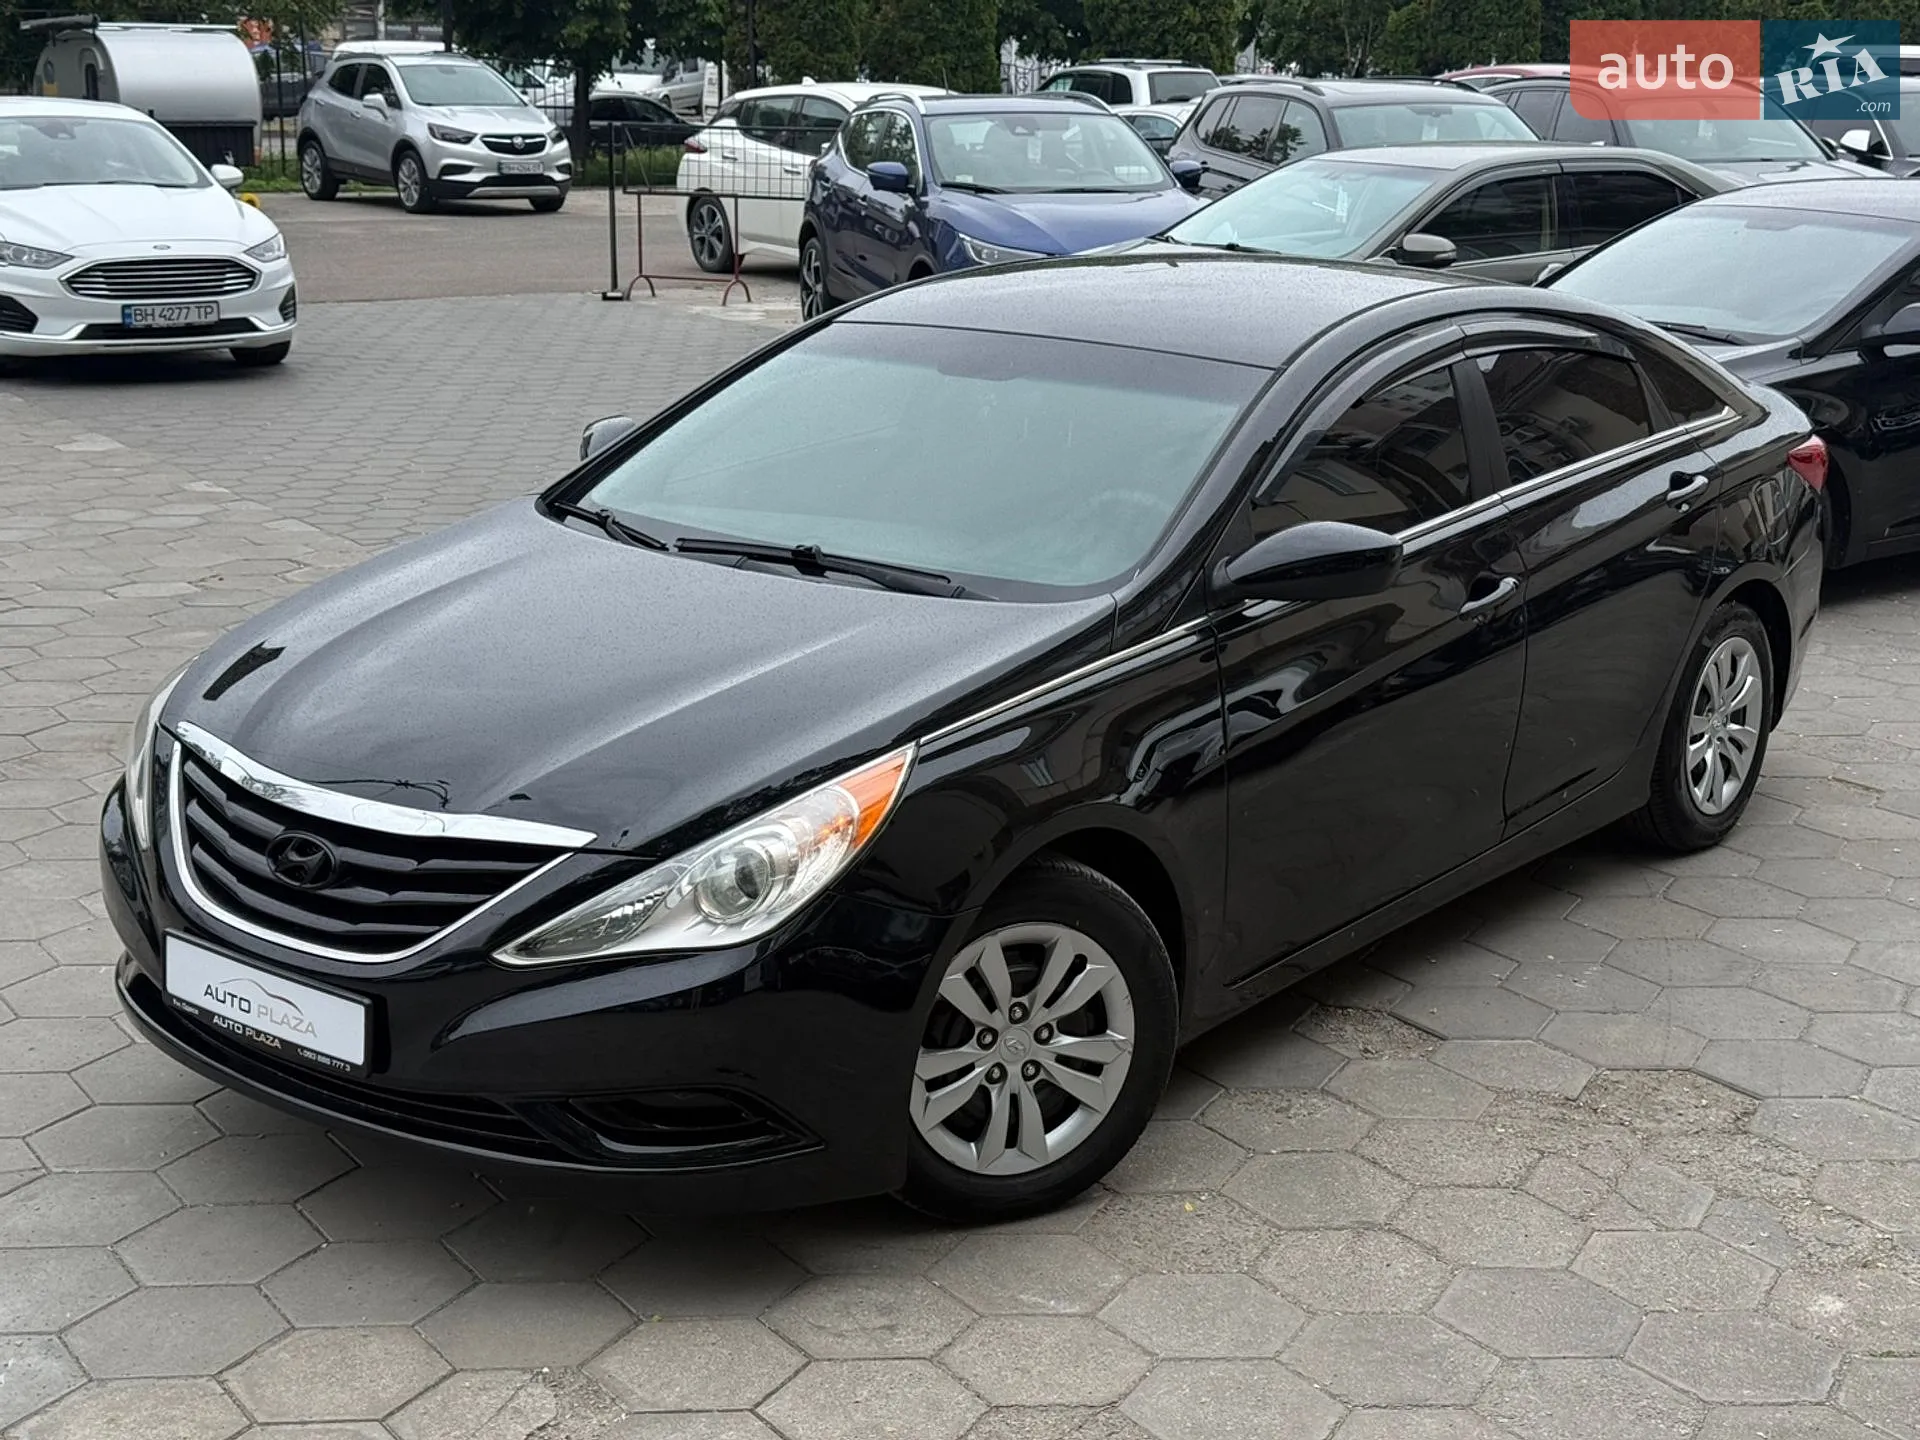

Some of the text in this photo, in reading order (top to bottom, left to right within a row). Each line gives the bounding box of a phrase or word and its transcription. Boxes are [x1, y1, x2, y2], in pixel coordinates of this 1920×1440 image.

[133, 304, 214, 323] BH 4277 TP
[203, 984, 252, 1014] AUTO
[257, 1004, 318, 1038] PLAZA
[213, 1015, 282, 1050] AUTO PLAZA
